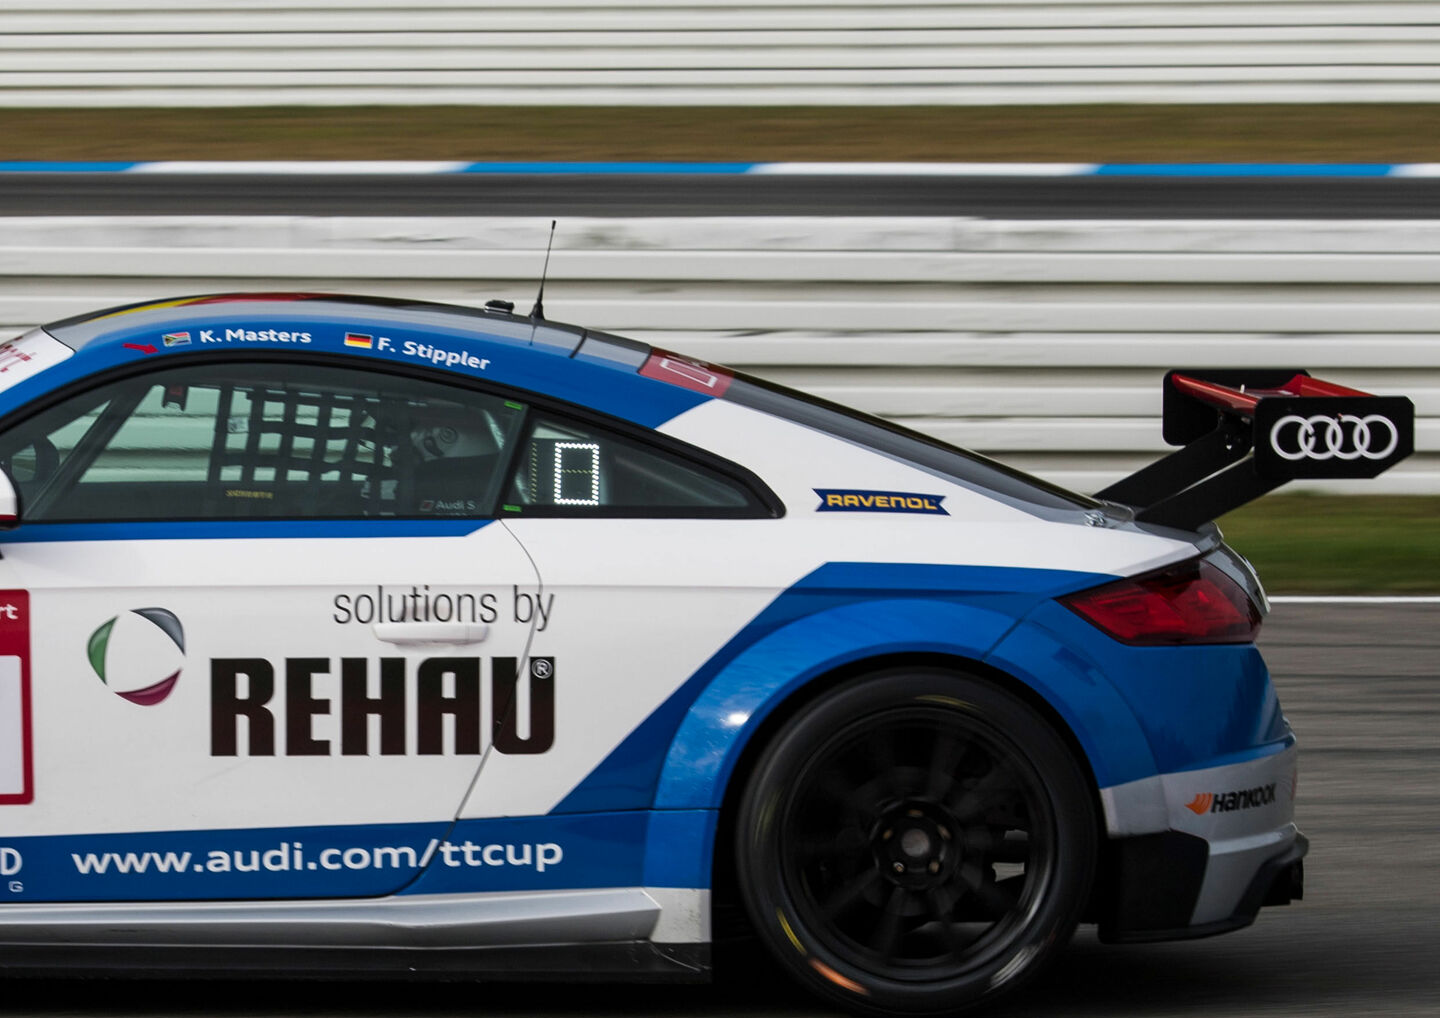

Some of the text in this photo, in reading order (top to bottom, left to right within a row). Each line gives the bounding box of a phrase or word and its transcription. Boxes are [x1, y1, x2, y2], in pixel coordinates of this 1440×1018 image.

[199, 329, 311, 343] K. Masters
[377, 337, 490, 370] F. Stippler
[333, 585, 555, 632] solutions by
[71, 838, 563, 874] www.audi.com/ttcup
